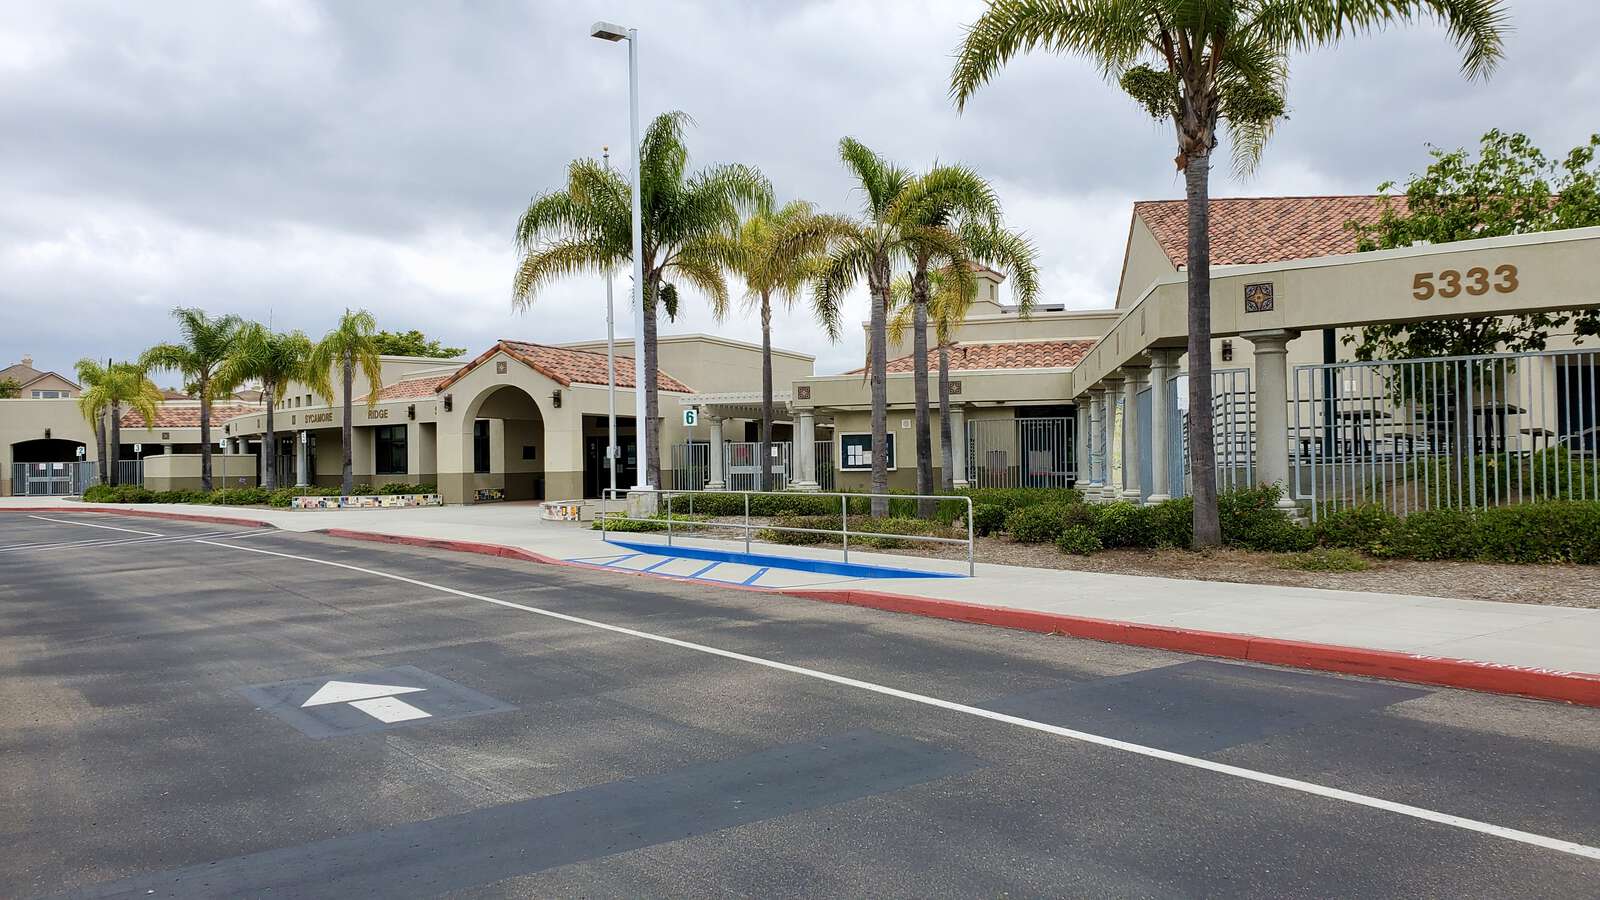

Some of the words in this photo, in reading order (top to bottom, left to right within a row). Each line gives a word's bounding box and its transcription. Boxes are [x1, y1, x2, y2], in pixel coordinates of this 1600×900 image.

[1412, 264, 1519, 301] 5333
[305, 413, 333, 424] SYCAMORE
[368, 409, 388, 420] RIDGE
[686, 411, 694, 425] 6
